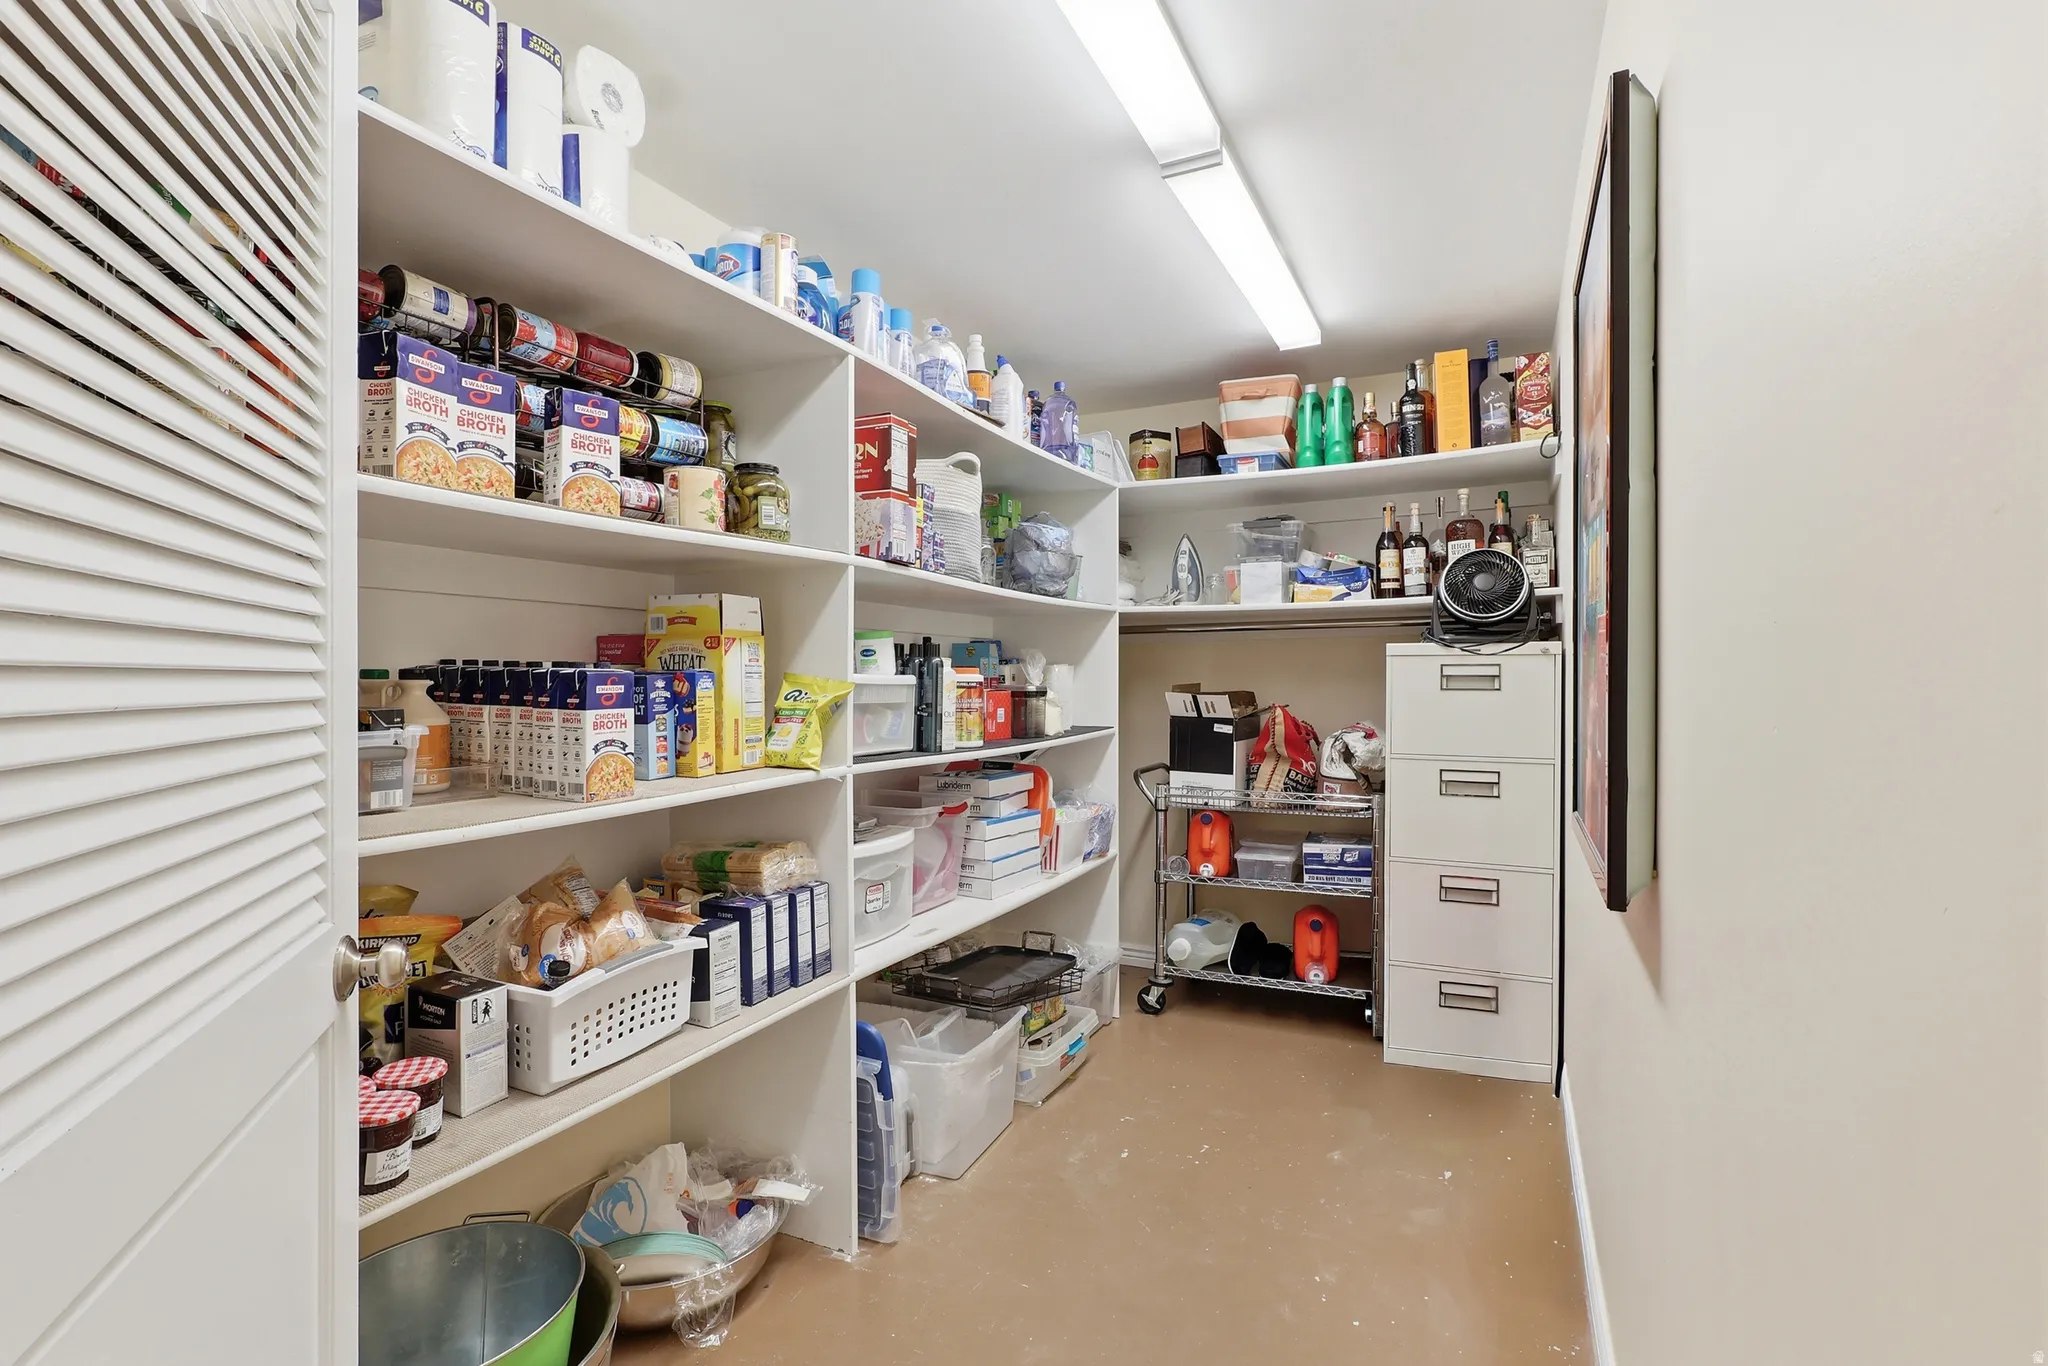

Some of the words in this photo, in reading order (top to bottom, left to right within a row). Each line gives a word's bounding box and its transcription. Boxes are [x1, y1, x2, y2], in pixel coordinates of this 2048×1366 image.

[410, 355, 444, 373] SWANSON
[464, 379, 501, 393] SWANSON
[407, 387, 446, 406] CHICKEN
[405, 396, 449, 418] BROTH
[576, 405, 607, 417] SWANSON
[460, 409, 504, 424] CHICKEN
[456, 416, 506, 436] BROTH
[572, 432, 610, 446] CHICKEN
[570, 438, 612, 455] BROTH
[657, 653, 706, 671] WHEAT
[562, 717, 581, 725] BROTH
[594, 712, 626, 720] CHICKEN
[592, 719, 628, 731] BROTH
[936, 780, 972, 790] Lubriderm
[359, 936, 418, 949] KIRKND
